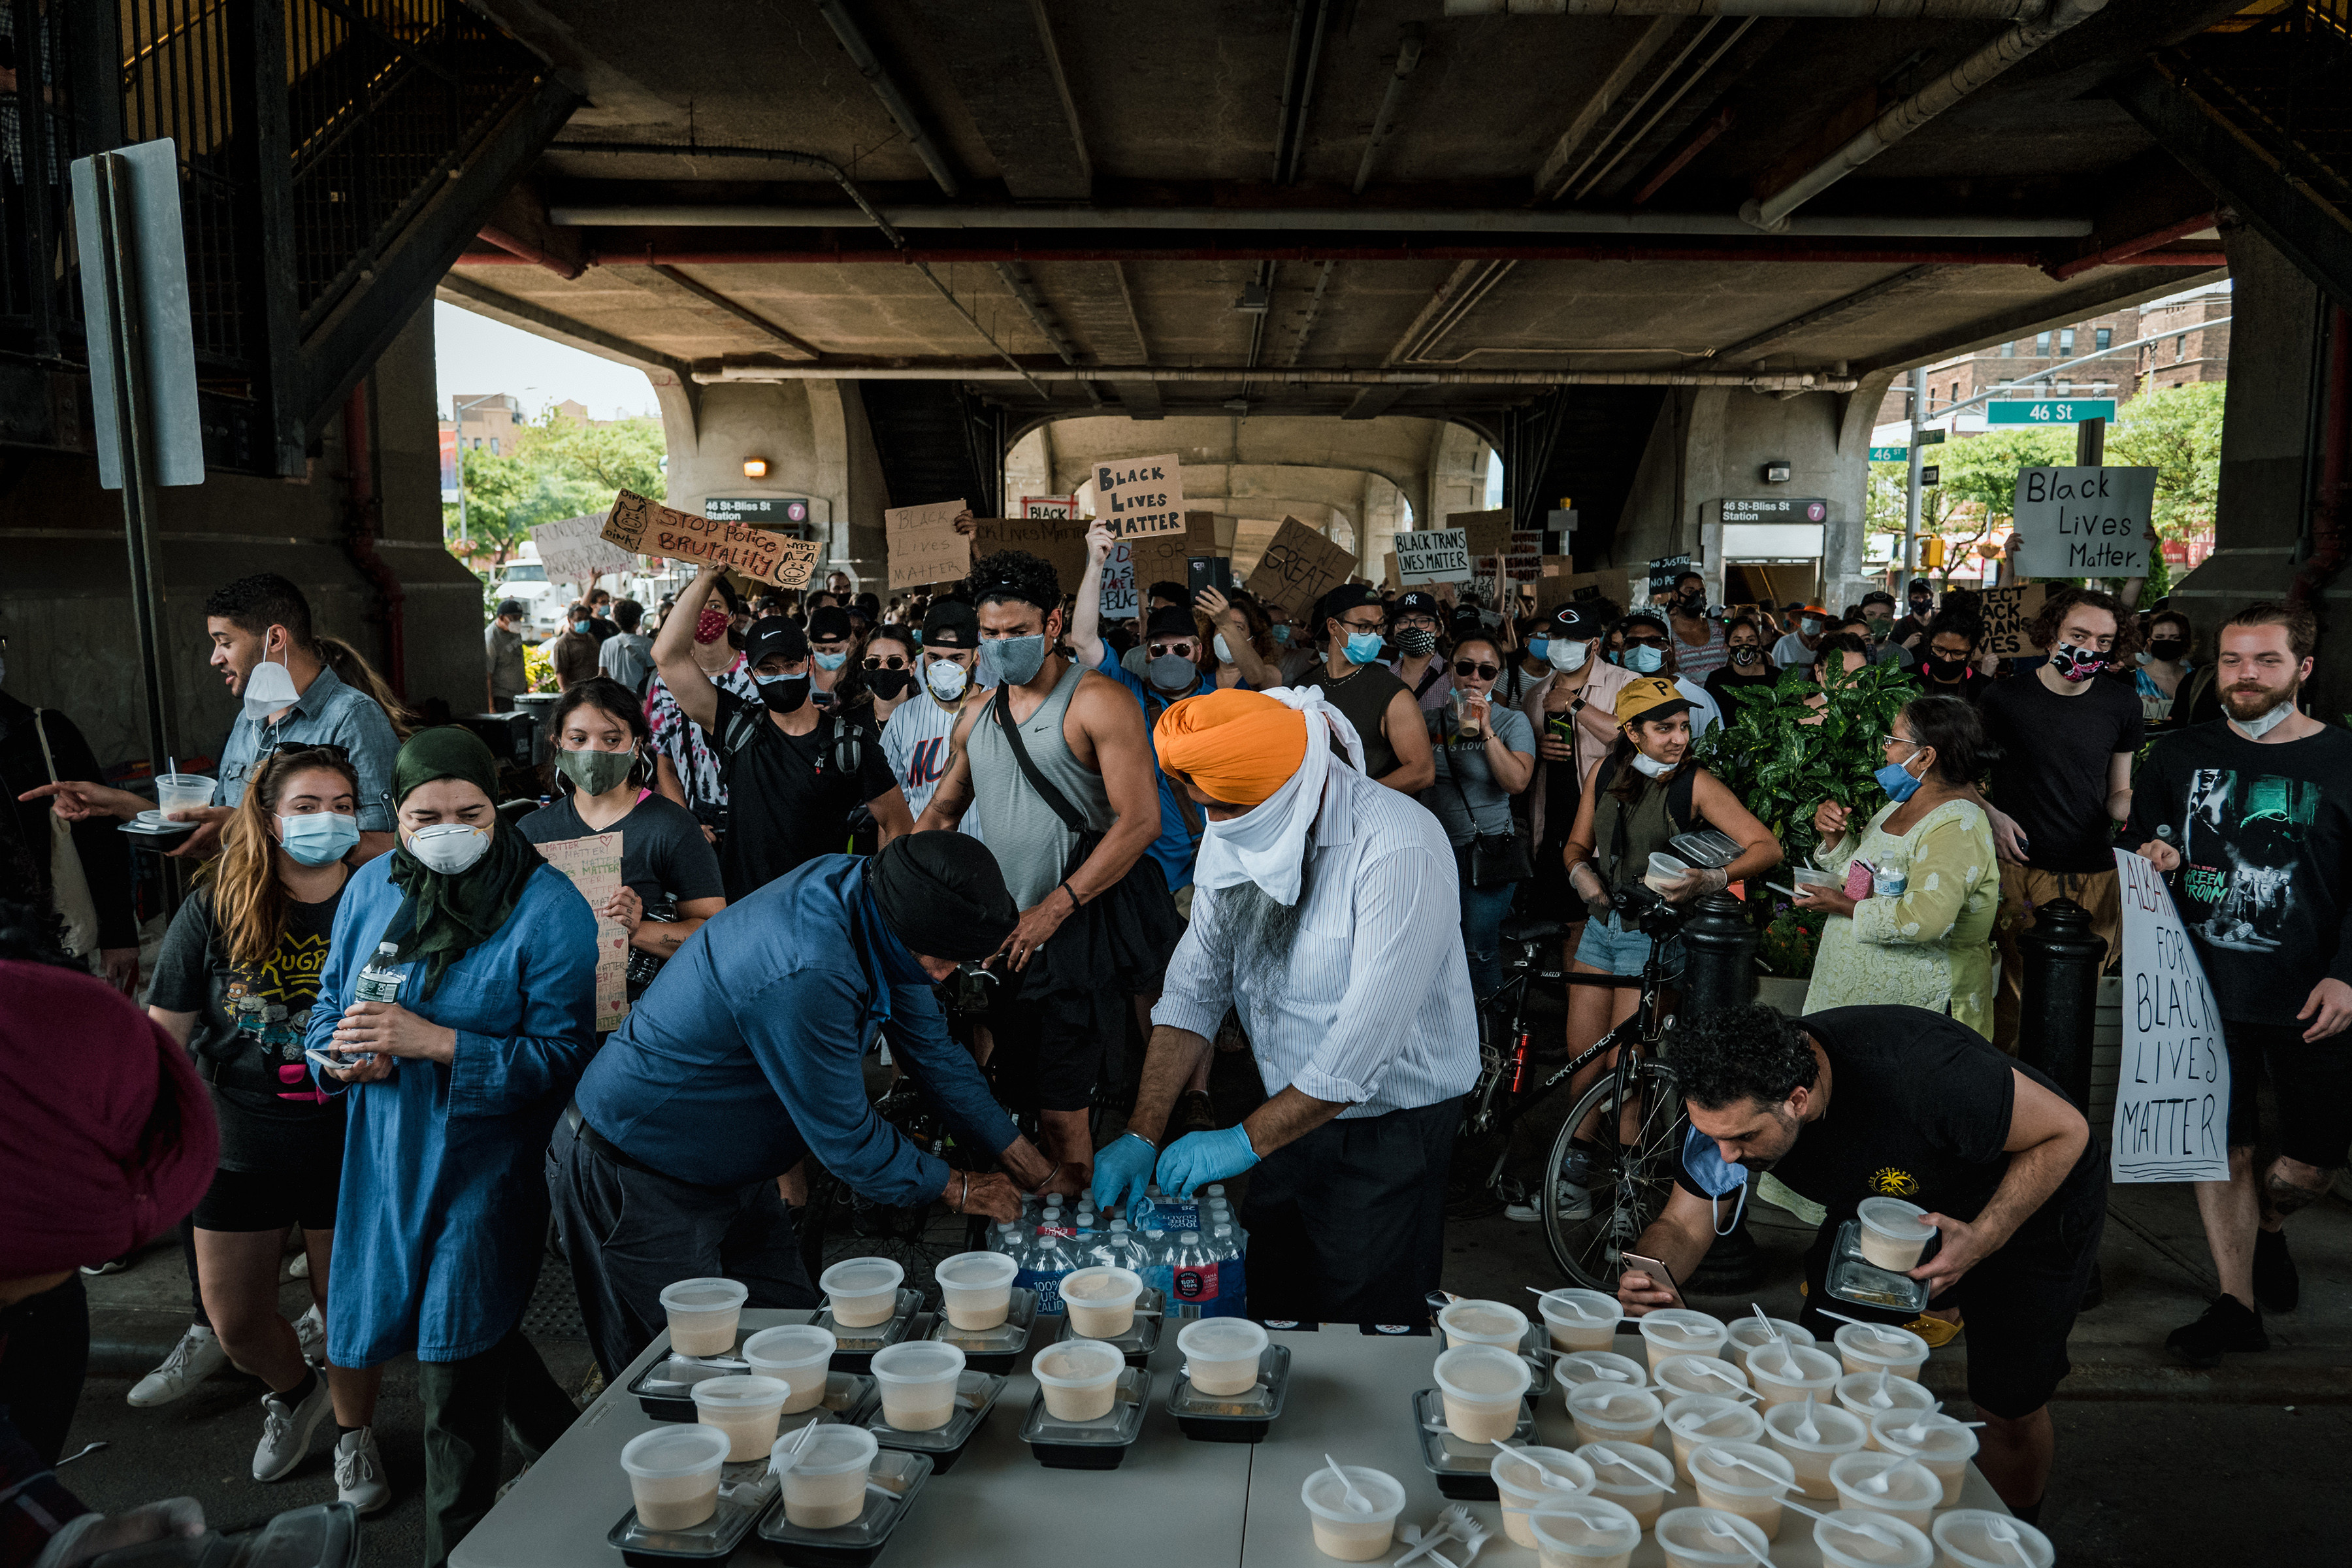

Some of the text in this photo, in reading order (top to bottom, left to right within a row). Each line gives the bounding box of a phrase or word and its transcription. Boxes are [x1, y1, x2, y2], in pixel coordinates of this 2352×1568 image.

[2030, 404, 2072, 420] 46 St
[1874, 449, 1891, 460] 46
[1099, 466, 1165, 491] BLACK
[2027, 470, 2110, 502] Black
[706, 502, 771, 511] 46 St-Bliss St
[1111, 493, 1167, 512] LIVES
[1723, 502, 1789, 511] 46 St-Bliss St
[706, 512, 741, 521] Station
[793, 507, 800, 517] 7
[896, 510, 947, 530] BLACK
[1030, 506, 1068, 519] BLACK
[1723, 512, 1758, 521] Station
[1812, 507, 1820, 517] 7
[660, 508, 718, 536] STOP
[1105, 512, 1181, 537] MATTER
[2059, 506, 2131, 536] Lives
[1041, 521, 1089, 542] MATTE
[1275, 523, 1348, 574] ARE WE
[1396, 532, 1430, 553] BLACK
[1431, 531, 1465, 549] TRANS
[1157, 543, 1188, 558] OR
[2069, 542, 2141, 568] Matter.
[1398, 551, 1467, 570] LIVES MATTER
[1650, 556, 1691, 569] NO JUSTICE
[1264, 545, 1335, 595] GREAT
[1650, 578, 1663, 587] NO
[1271, 576, 1315, 615] YET
[1405, 594, 1418, 605] NY
[1977, 586, 2027, 602] TECT
[1982, 603, 2021, 620] ACK
[1982, 617, 2031, 636] RANS
[1978, 635, 2021, 653] VES
[1652, 681, 1668, 696] P
[546, 841, 579, 852] MATTER
[565, 846, 608, 859] MATTER!
[575, 875, 604, 885] TTER!
[2183, 869, 2226, 889] GREEN
[591, 897, 610, 907] MAT
[2187, 885, 2228, 904] ROOM
[2157, 926, 2191, 978] FOR
[261, 948, 327, 986] RUGR
[2136, 972, 2215, 1033] BLACK
[597, 1013, 622, 1028] ATTER
[2135, 1036, 2217, 1084] LIVES
[2121, 1093, 2218, 1158] MATTER
[1876, 1167, 1911, 1178] ANGELES
[1034, 1280, 1061, 1292] 100%
[1040, 1292, 1060, 1302] UR
[1037, 1300, 1064, 1312] CALID
